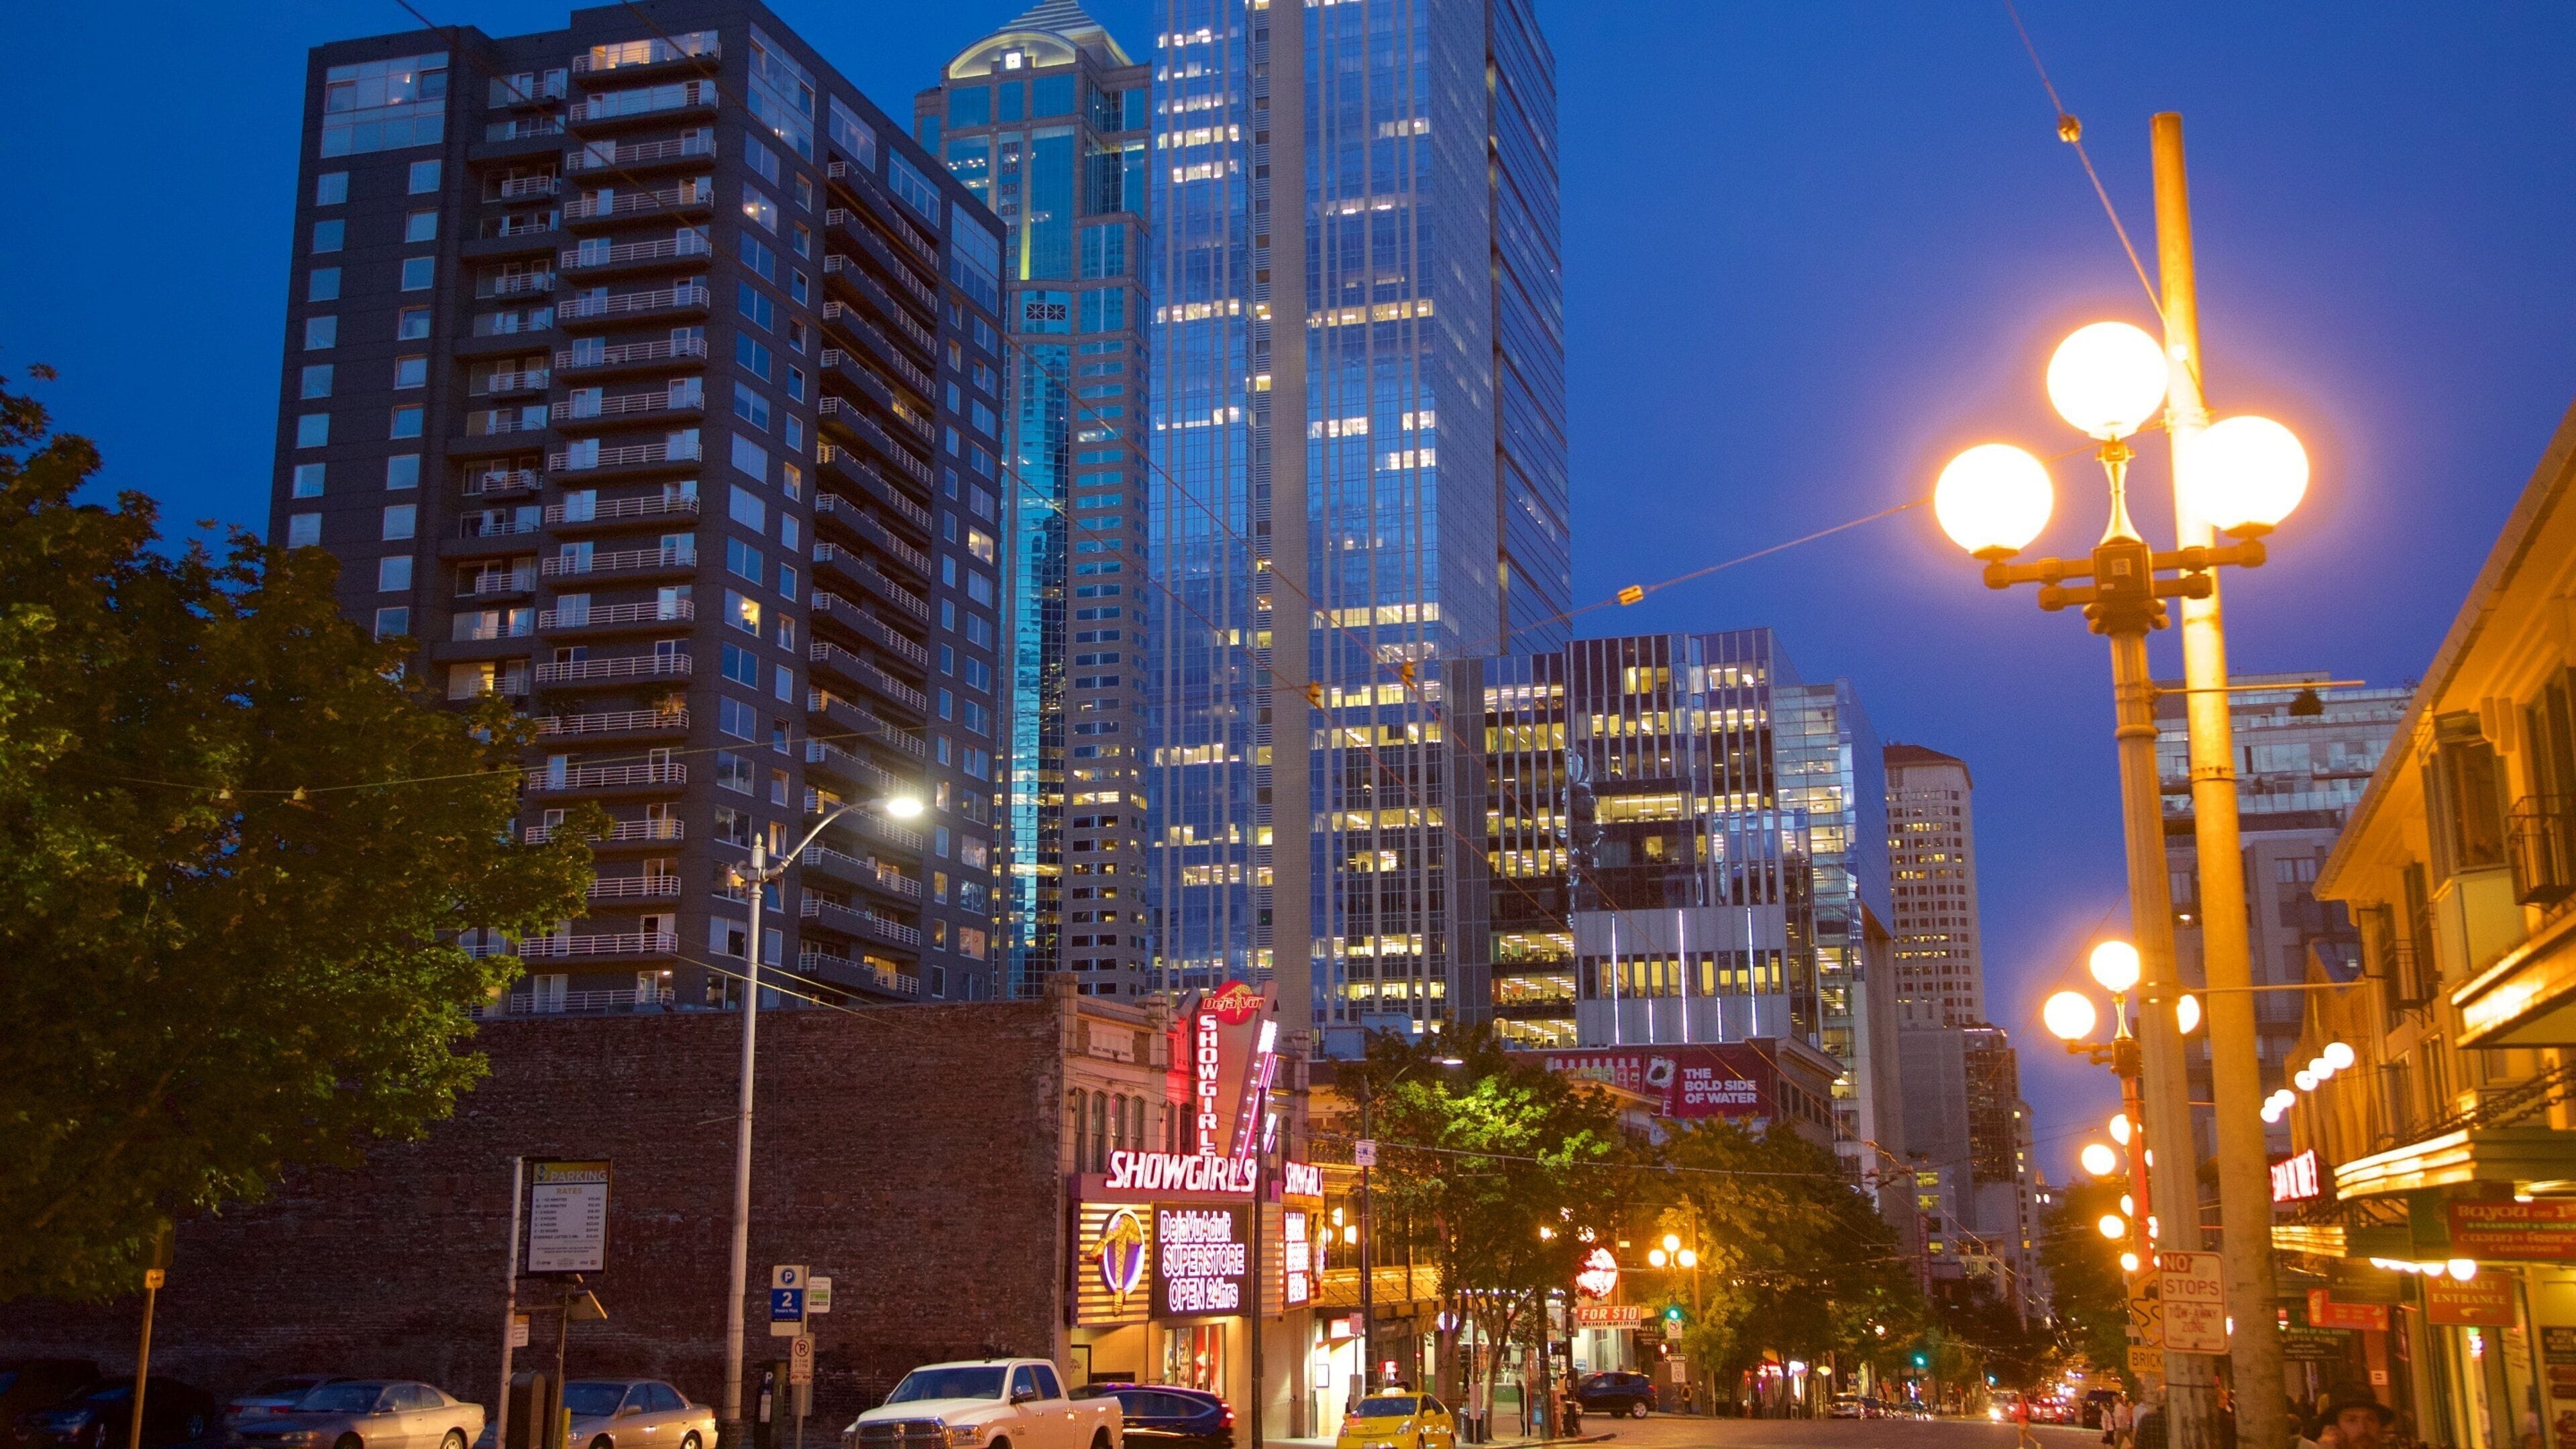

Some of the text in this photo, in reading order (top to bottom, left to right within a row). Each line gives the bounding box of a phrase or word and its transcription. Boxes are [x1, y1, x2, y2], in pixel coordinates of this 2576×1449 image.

[1240, 997, 1259, 1008] Vu
[1683, 1068, 1711, 1079] THE
[1684, 1080, 1756, 1091] BOLD SIDE
[1684, 1093, 1757, 1104] OF WATER
[551, 1170, 606, 1181] PARKING
[1106, 1150, 1257, 1192] SHOWGIRLS
[2457, 1205, 2529, 1221] Bayou
[1163, 1243, 1244, 1277] SUPERSTORE
[2162, 1255, 2188, 1271] NO
[1169, 1277, 1238, 1311] OPEN 24hrs
[2165, 1279, 2219, 1295] STOPS
[782, 1291, 792, 1307] 2
[2432, 1293, 2507, 1304] ENTRANCE
[1581, 1307, 1638, 1320] FOR $10
[2182, 1322, 2207, 1333] ZONE
[2132, 1352, 2163, 1368] BRICK
